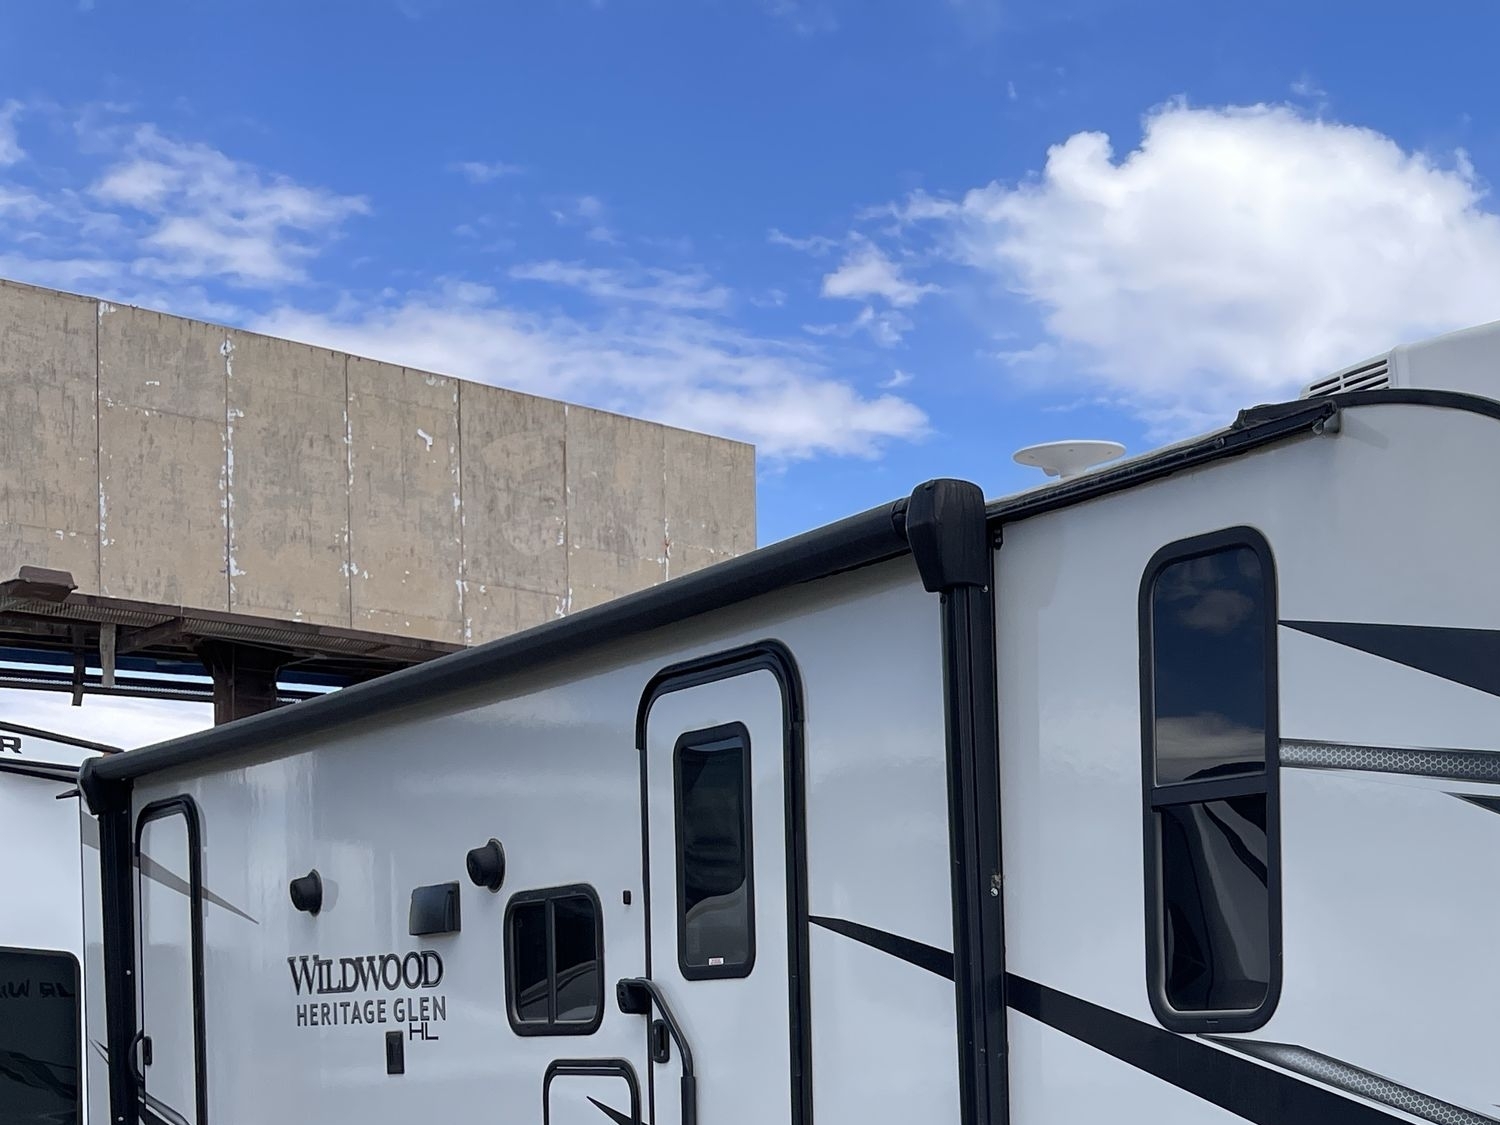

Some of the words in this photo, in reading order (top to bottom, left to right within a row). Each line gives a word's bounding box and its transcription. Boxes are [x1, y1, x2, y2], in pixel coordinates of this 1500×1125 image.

[287, 949, 444, 996] WILDWOOD
[296, 999, 387, 1027] HERITAGE
[393, 995, 447, 1023] GLEN
[408, 1021, 439, 1041] HL
